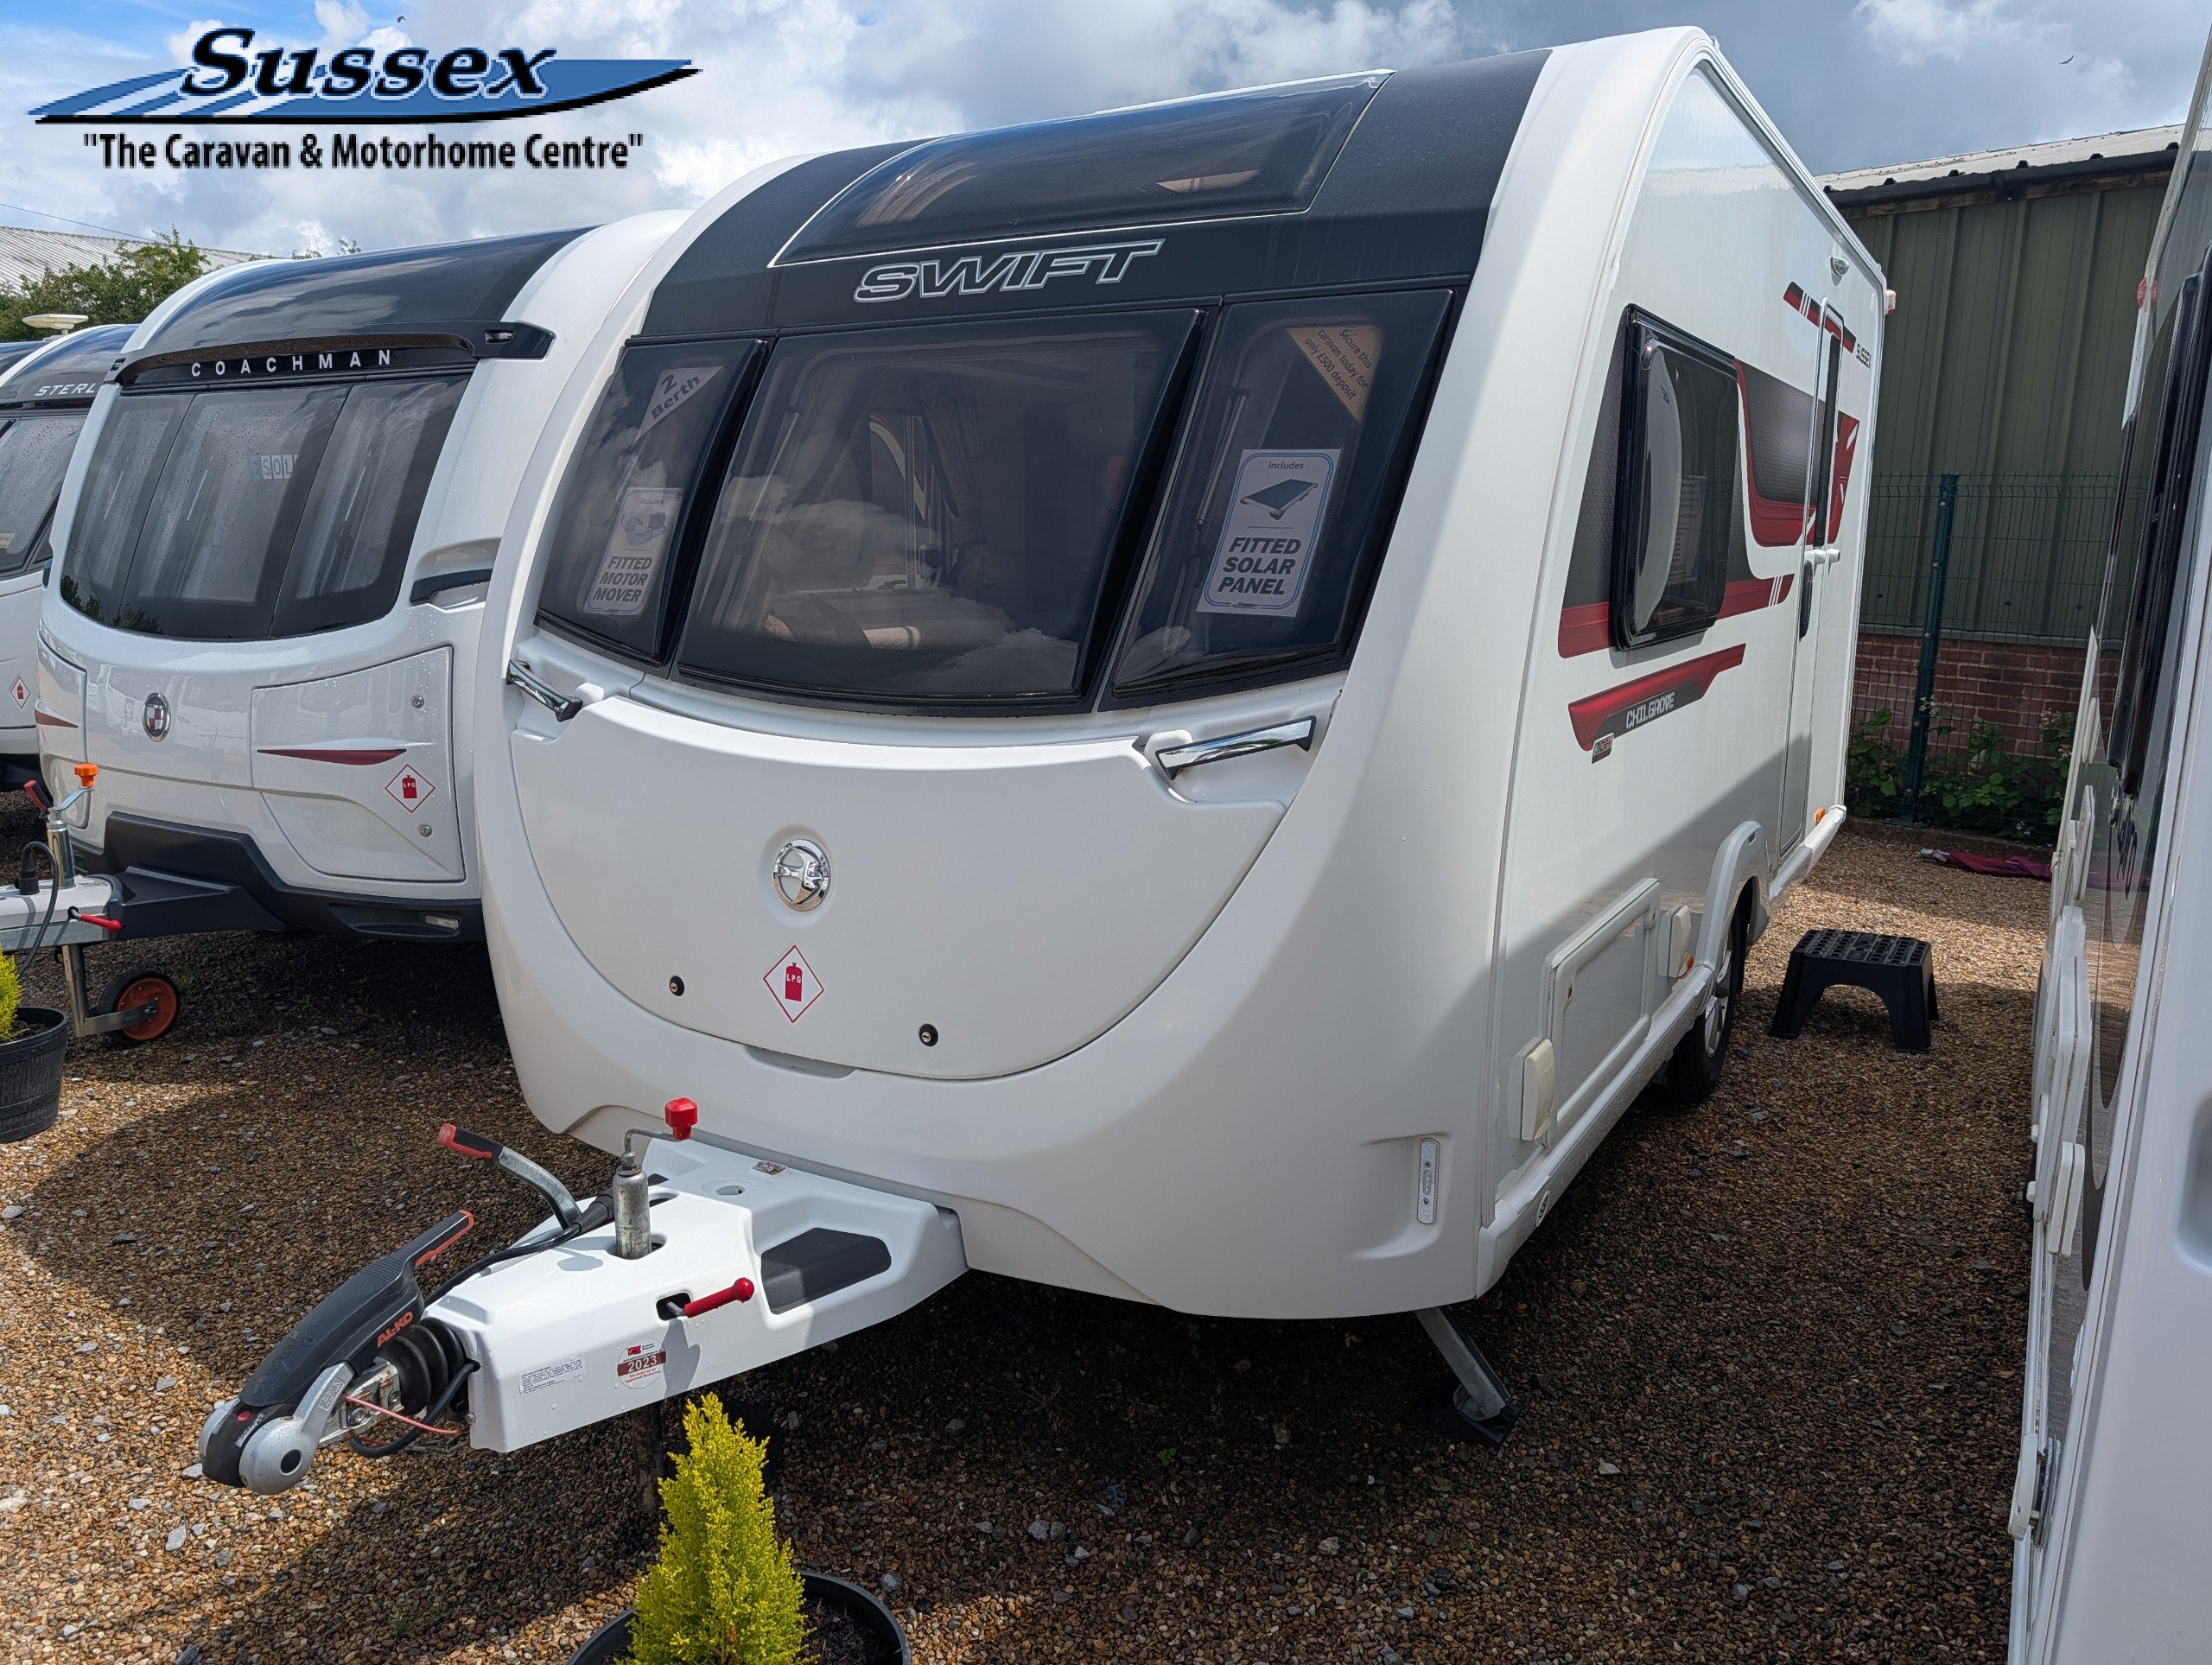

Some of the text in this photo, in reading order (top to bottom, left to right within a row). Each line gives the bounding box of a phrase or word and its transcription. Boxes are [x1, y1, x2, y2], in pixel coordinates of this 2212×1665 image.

[854, 238, 1166, 302] SWIFT
[1338, 328, 1373, 369] Secure this
[191, 349, 391, 378] COACHMAN
[1305, 338, 1357, 400] only £500 deposit
[1318, 330, 1369, 389] caravan today for
[35, 382, 100, 397] STERL
[661, 373, 677, 396] 2
[651, 375, 701, 420] Berth
[1268, 461, 1304, 470] Includes
[1228, 537, 1302, 555] FITTED
[607, 556, 653, 570] FITTED
[1223, 556, 1296, 575] SOLAR
[599, 571, 649, 586] MOTOR
[1217, 576, 1286, 595] PANEL
[592, 588, 643, 602] MOVER
[1625, 691, 1675, 729] CHILGROVE
[786, 973, 802, 983] LPG
[377, 1310, 414, 1348] AL-KO
[627, 1355, 658, 1373] 2023
